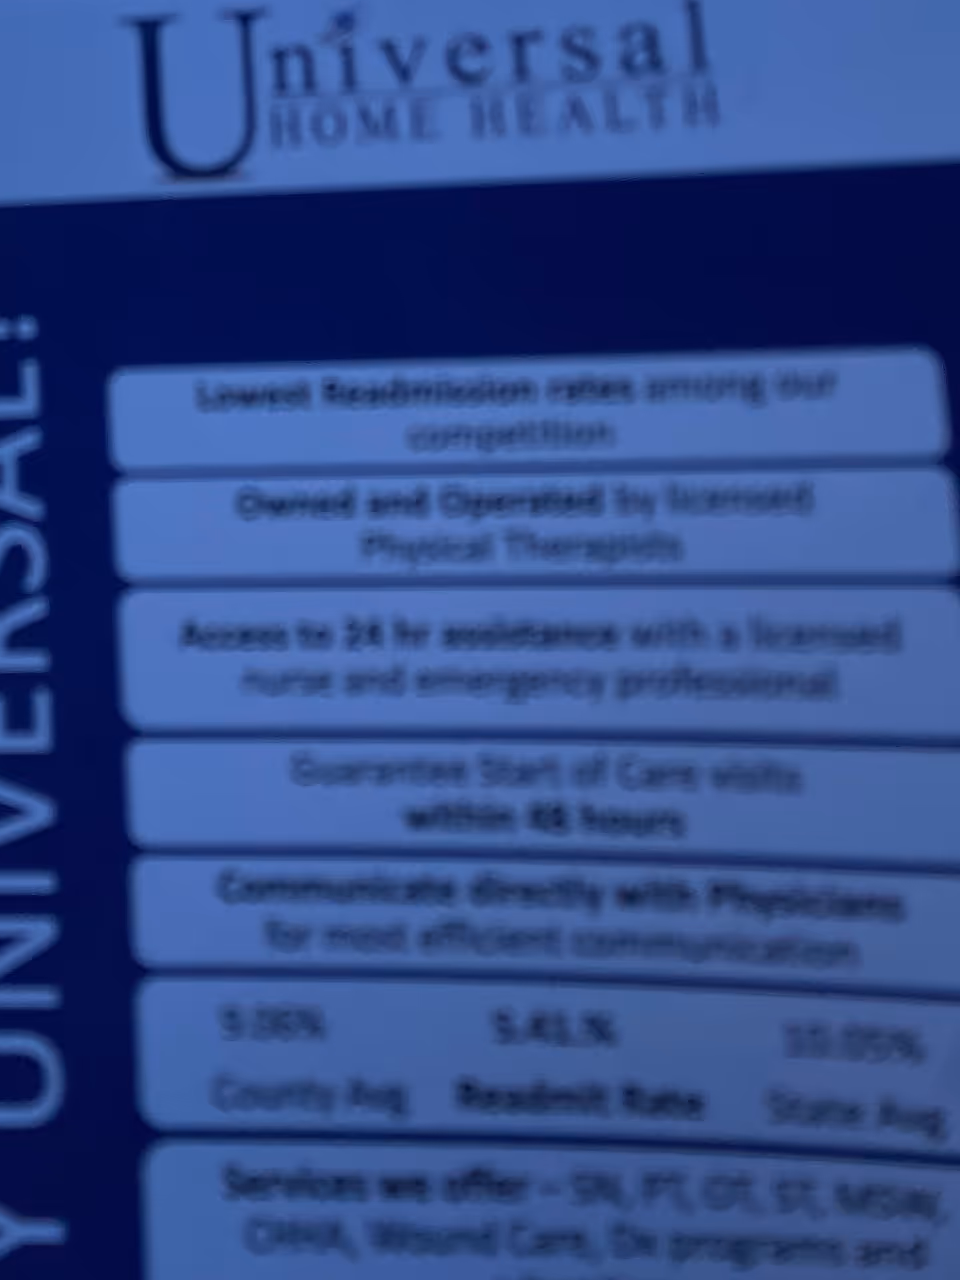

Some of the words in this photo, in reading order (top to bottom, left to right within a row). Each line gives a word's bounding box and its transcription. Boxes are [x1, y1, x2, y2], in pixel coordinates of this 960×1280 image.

[268, 97, 437, 151] HOME
[469, 83, 721, 140] HEALTH
[195, 377, 310, 414] Lowest
[322, 372, 537, 409] Readmission
[548, 374, 634, 405] rates
[235, 485, 355, 520] Owned
[367, 485, 428, 517] and
[439, 482, 604, 523] Operated
[181, 616, 289, 650] Access
[296, 618, 332, 650] to
[345, 616, 383, 650] 24
[393, 615, 430, 648] hr
[442, 615, 618, 650] assistance
[630, 615, 706, 650] with
[345, 665, 406, 697] and
[415, 668, 604, 705] emergency
[615, 662, 838, 701] professional
[476, 752, 559, 786] Start
[571, 752, 607, 787] of
[617, 753, 697, 791] Care
[404, 801, 515, 832] within
[528, 801, 568, 835] 48
[579, 803, 686, 839] hours
[216, 867, 455, 906] Communicate
[470, 870, 600, 914] directly
[616, 876, 693, 910] with
[708, 878, 906, 924] Physicians
[455, 1074, 609, 1117] Readmit
[622, 1078, 706, 1121] Rate
[221, 1160, 365, 1201] Services
[378, 1170, 426, 1201] we
[445, 1162, 528, 1202] offer
